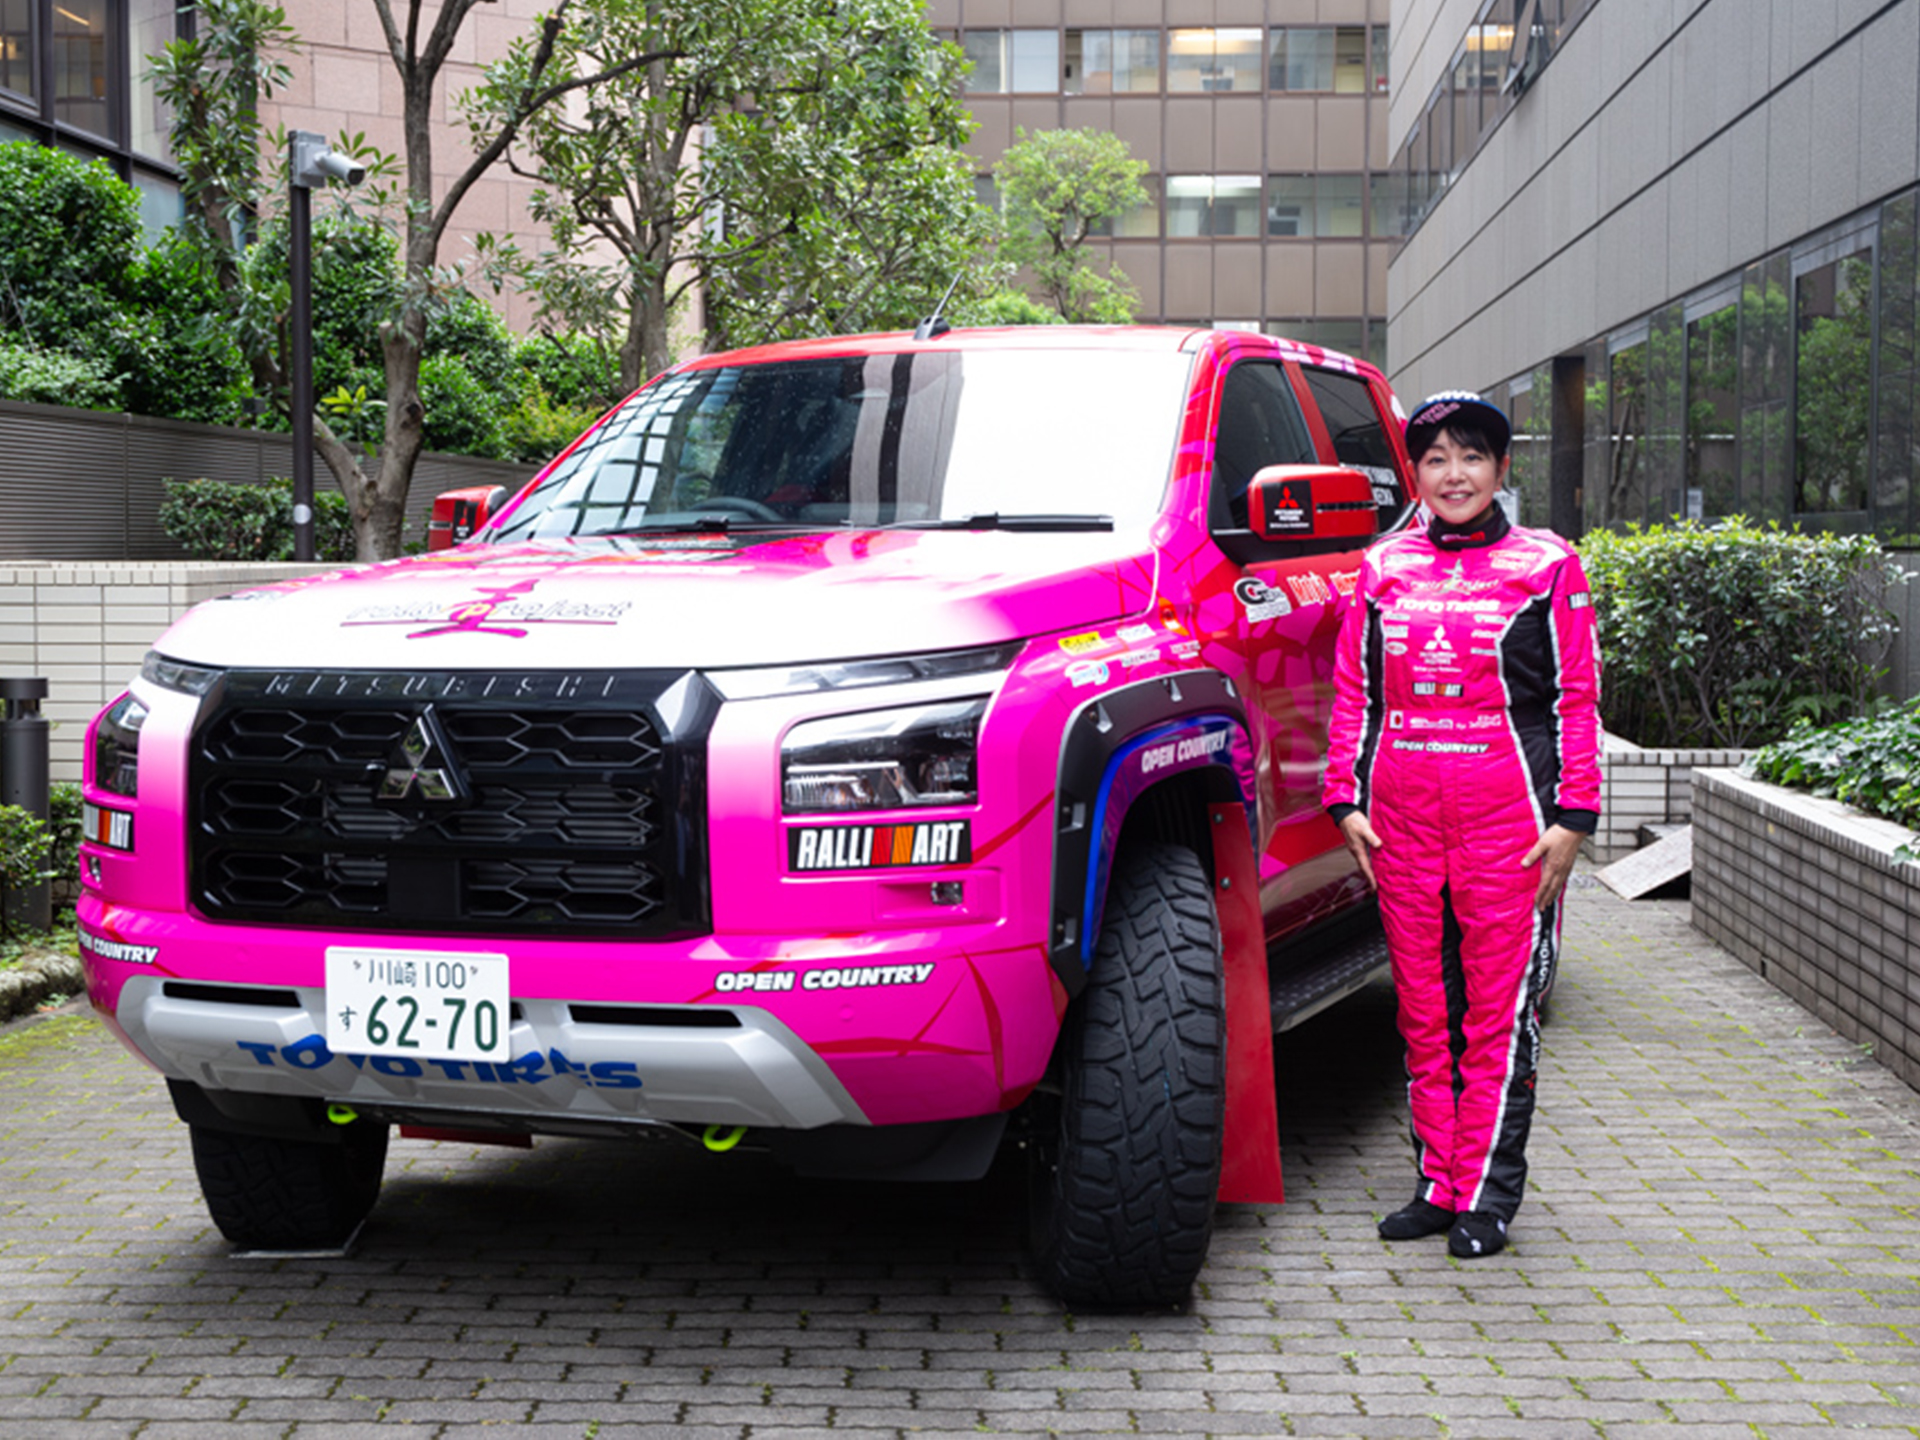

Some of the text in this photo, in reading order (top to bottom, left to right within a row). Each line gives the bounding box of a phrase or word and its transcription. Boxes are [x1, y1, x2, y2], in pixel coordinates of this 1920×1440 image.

[1395, 598, 1444, 613] TOYO
[265, 675, 615, 696] MITSUBISHI
[1141, 729, 1228, 773] OPEN COUNTRY
[1426, 741, 1490, 754] COUNTRY
[94, 936, 160, 964] COUNTRY
[715, 963, 936, 992] OPEN COUNTRY
[338, 994, 498, 1052] す 62-70
